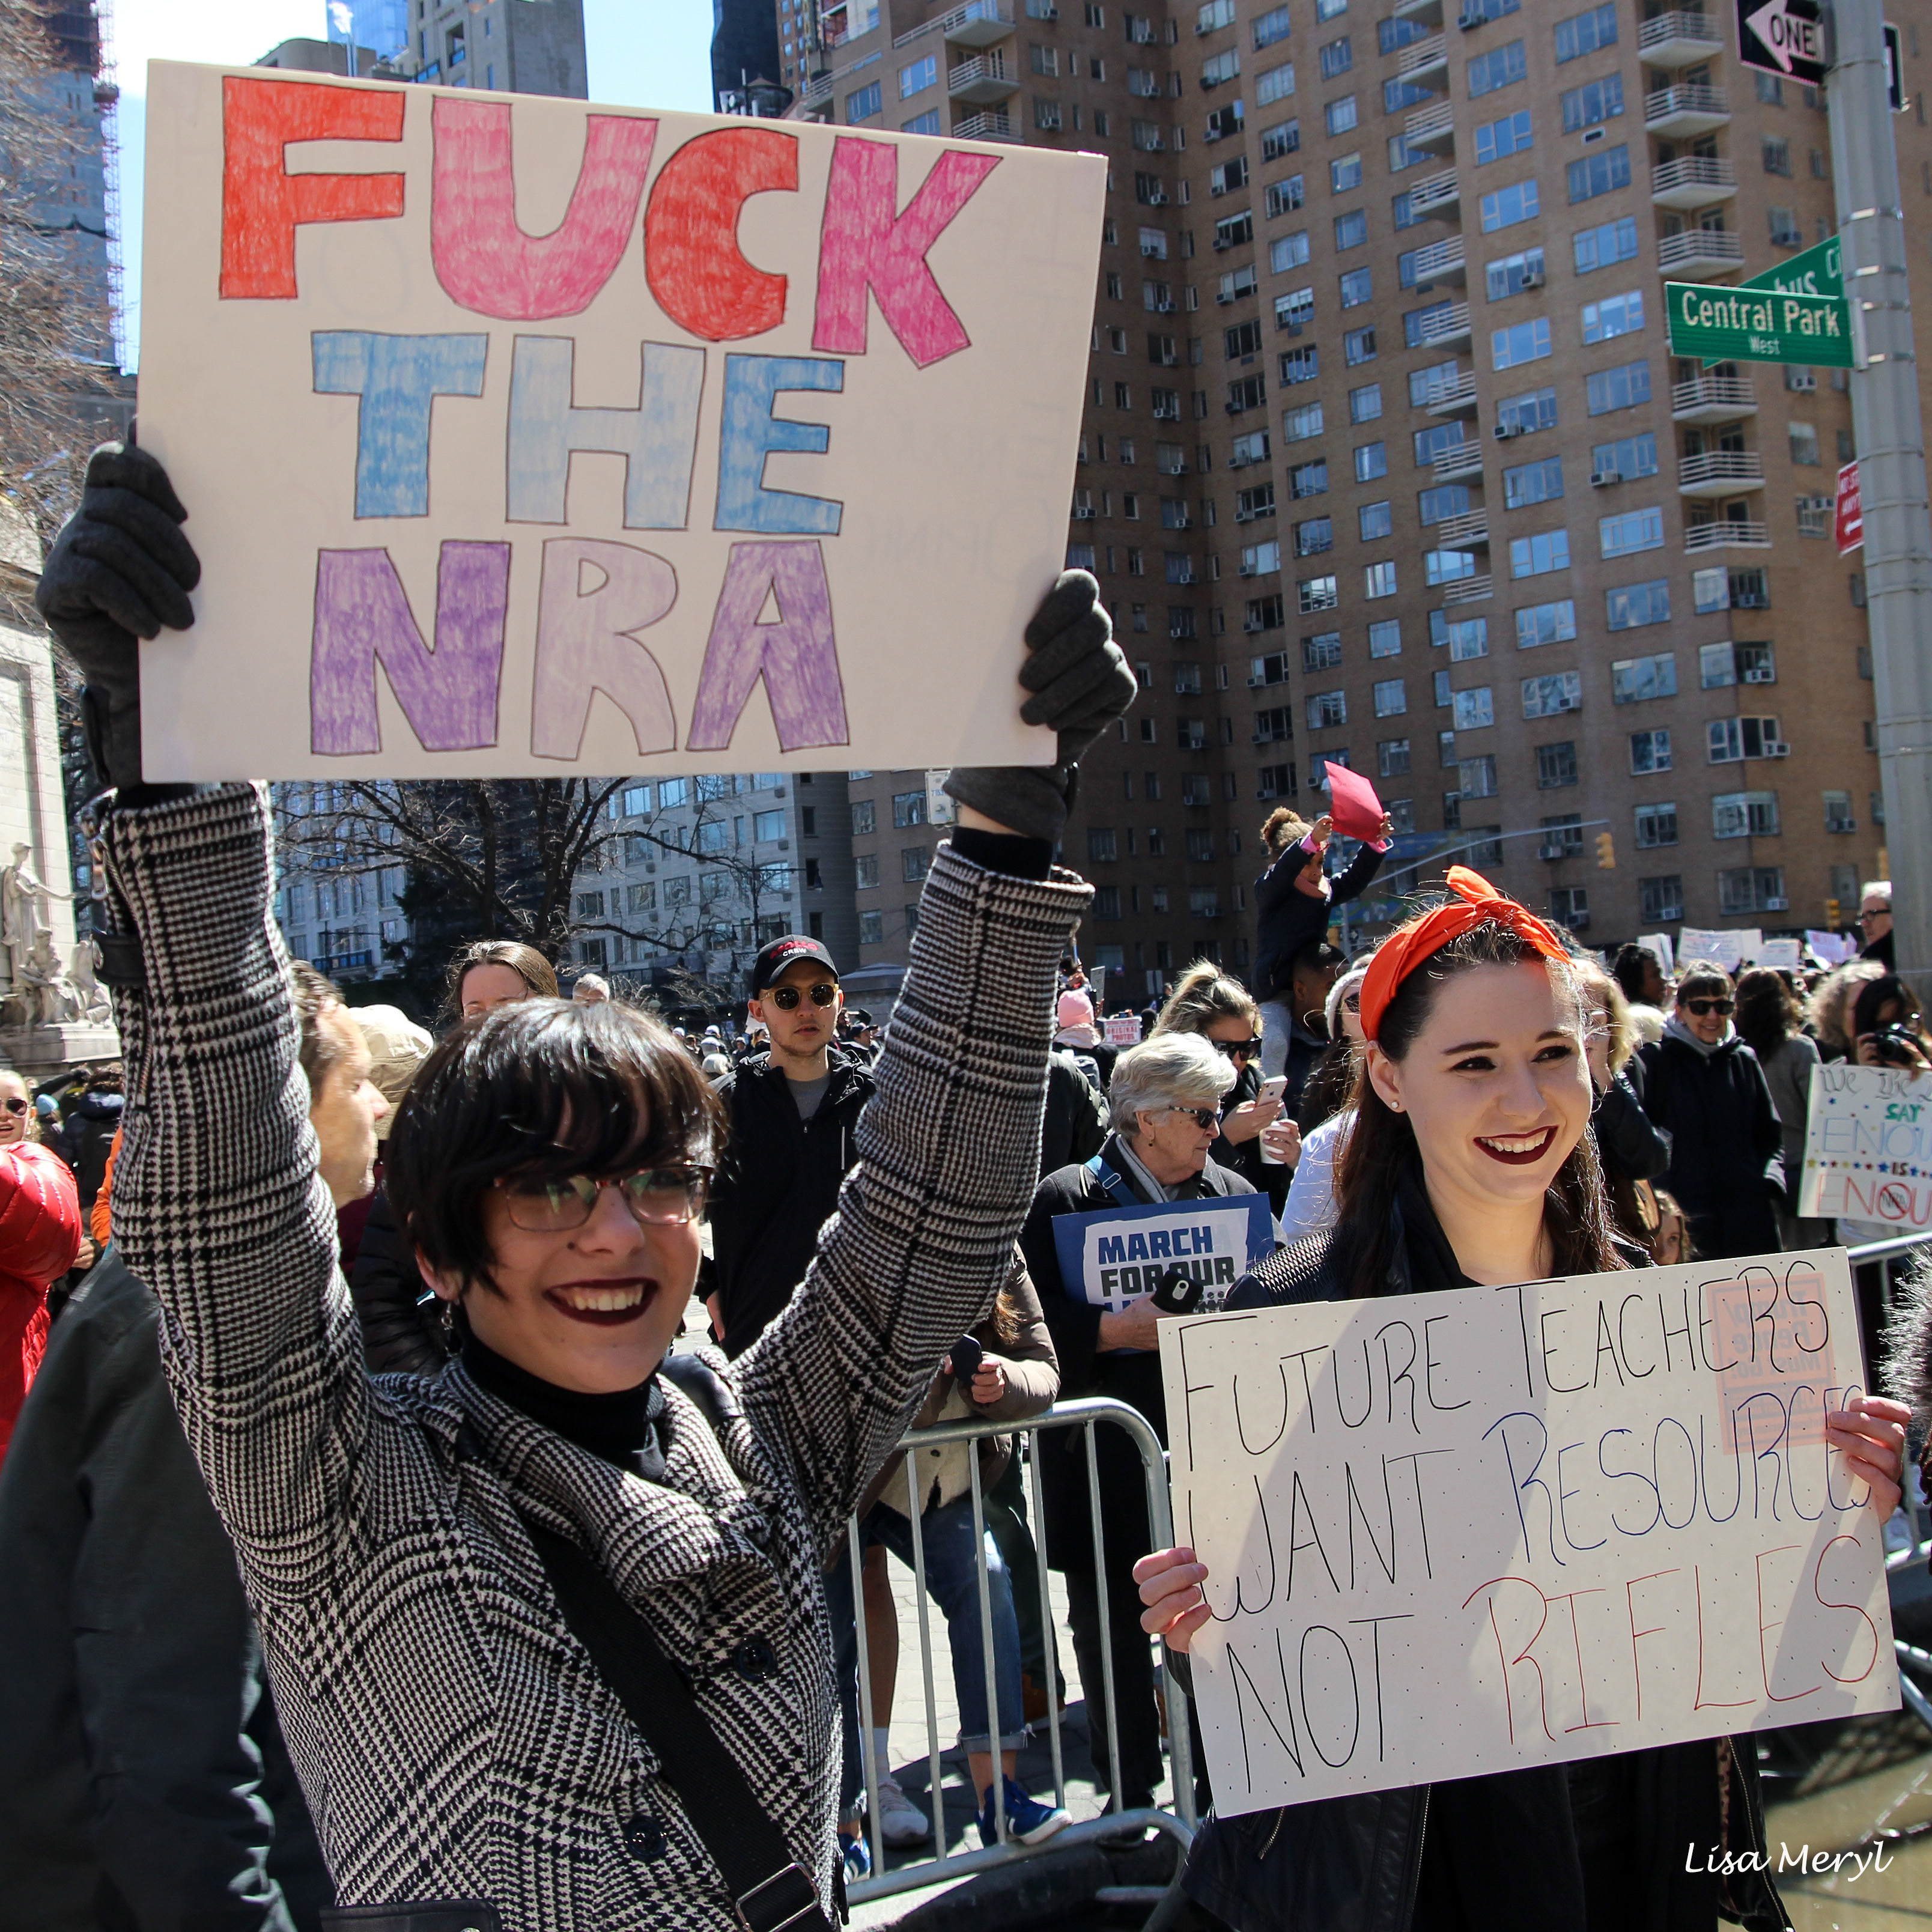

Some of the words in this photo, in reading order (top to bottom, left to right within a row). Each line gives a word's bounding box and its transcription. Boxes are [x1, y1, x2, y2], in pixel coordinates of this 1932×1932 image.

[1771, 13, 1817, 56] ONE
[218, 75, 1004, 370] FUCK
[1683, 290, 1773, 332] Central
[1784, 300, 1841, 337] Park
[1748, 335, 1781, 355] West
[311, 330, 846, 536] THE
[309, 537, 851, 761] NRA
[782, 947, 806, 956] CREW
[1819, 1068, 1862, 1095] We
[1885, 1103, 1922, 1123] SAY
[1892, 1162, 1911, 1177] IS
[1098, 1226, 1214, 1265] MARCH
[1101, 1263, 1164, 1297] FOR
[1179, 1316, 1471, 1471] FUTURE
[1496, 1260, 1829, 1399] TEACHERS
[1188, 1449, 1456, 1622] WANT
[1226, 1614, 1414, 1794] NOT
[1462, 1536, 1879, 1745] RIFLES
